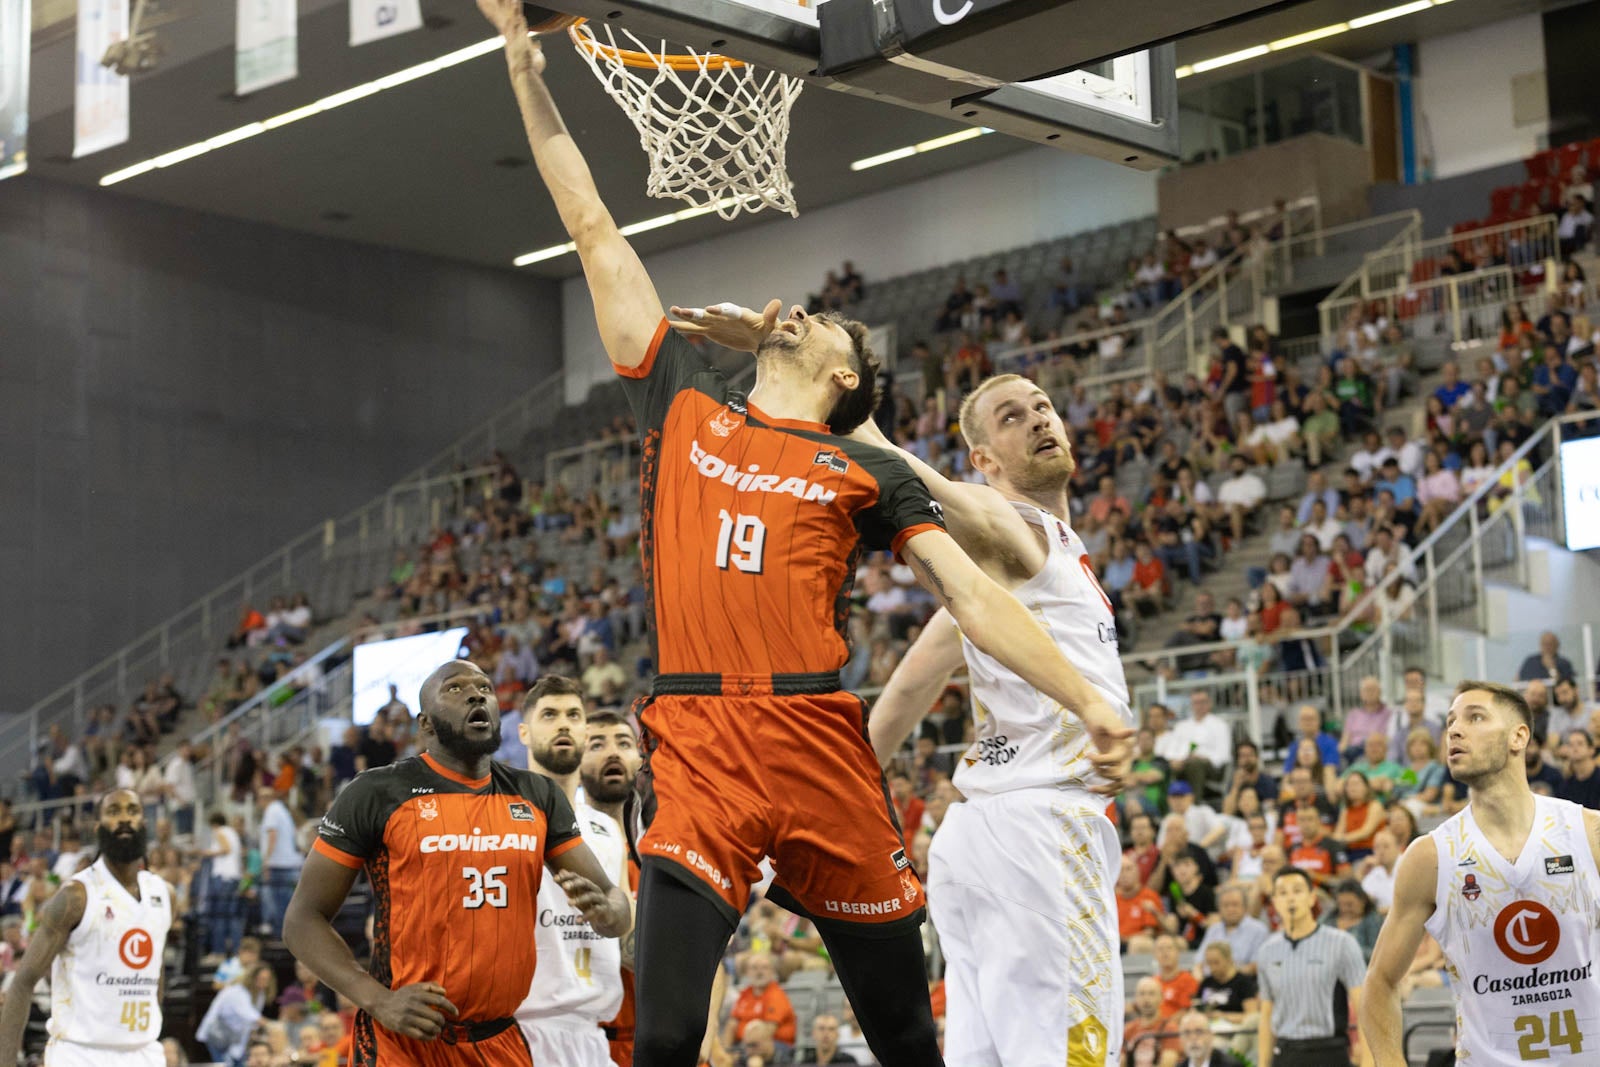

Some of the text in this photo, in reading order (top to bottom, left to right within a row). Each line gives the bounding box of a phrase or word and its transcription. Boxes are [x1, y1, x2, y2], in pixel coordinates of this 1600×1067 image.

[715, 508, 767, 575] 19
[462, 866, 508, 909] 35
[842, 897, 902, 915] BERNER
[574, 947, 593, 987] 4
[120, 1001, 151, 1032] 45
[1511, 988, 1573, 1006] ZARAGOZA
[1513, 1008, 1584, 1061] 24
